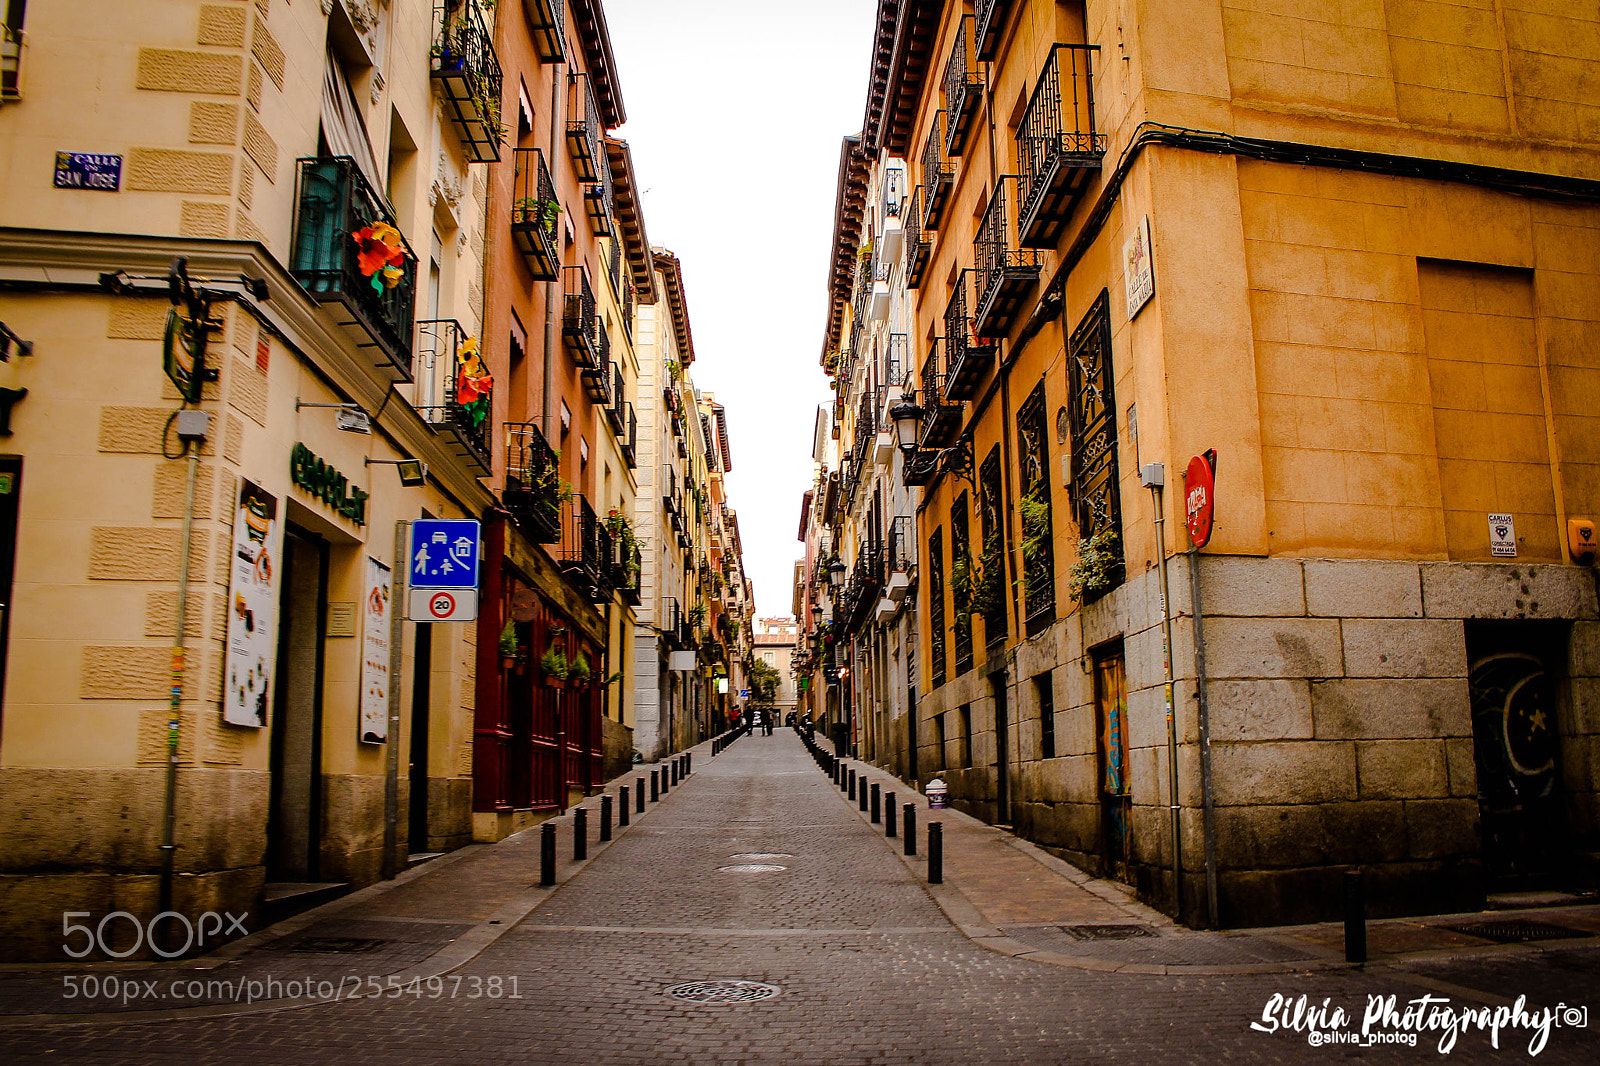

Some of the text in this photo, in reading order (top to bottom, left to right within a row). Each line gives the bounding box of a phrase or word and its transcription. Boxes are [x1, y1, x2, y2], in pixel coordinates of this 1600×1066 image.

[74, 154, 119, 167] CALLE
[57, 170, 81, 186] SAN
[434, 600, 450, 610] 20
